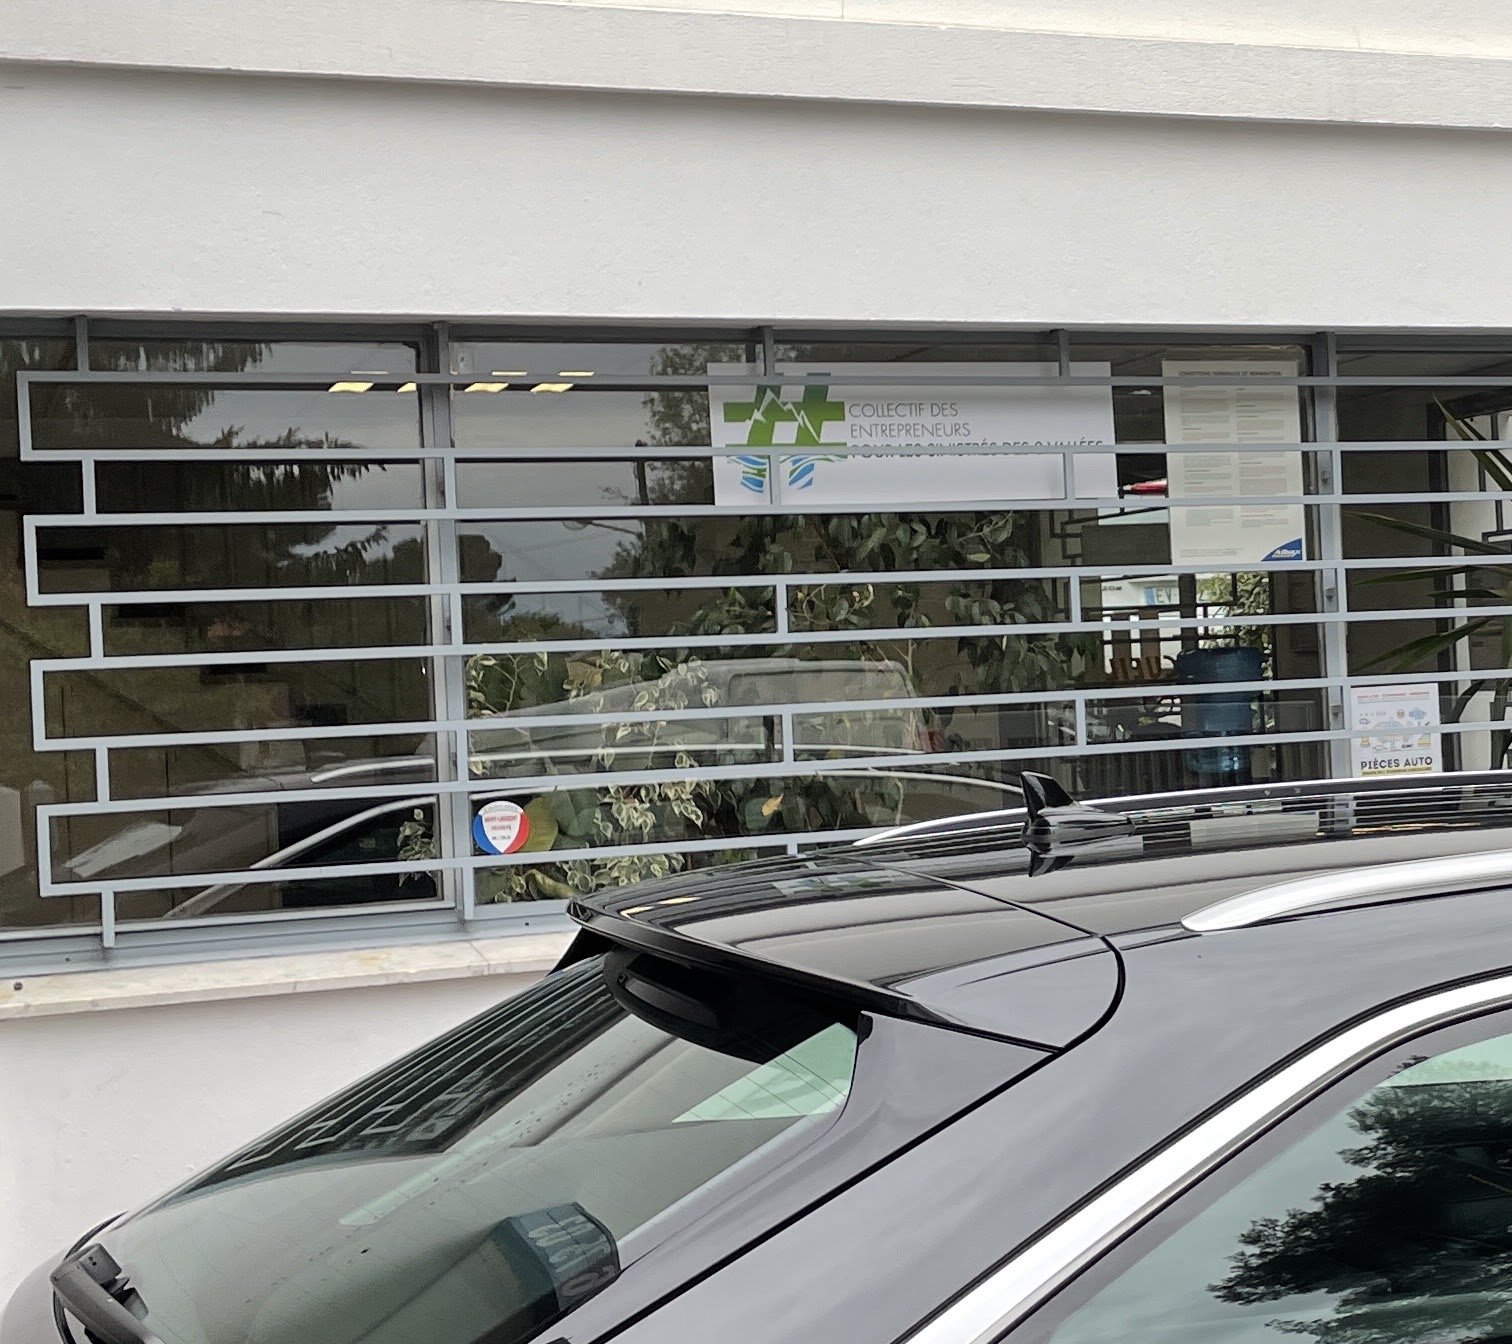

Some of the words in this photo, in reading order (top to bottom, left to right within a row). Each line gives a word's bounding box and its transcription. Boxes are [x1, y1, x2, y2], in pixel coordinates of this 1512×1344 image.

[848, 402, 926, 419] COLLECTIF
[930, 402, 959, 418] DES
[850, 422, 971, 439] ENTREPRENEURS
[1360, 758, 1401, 771] PIÈCES
[1403, 756, 1433, 767] AUTO
